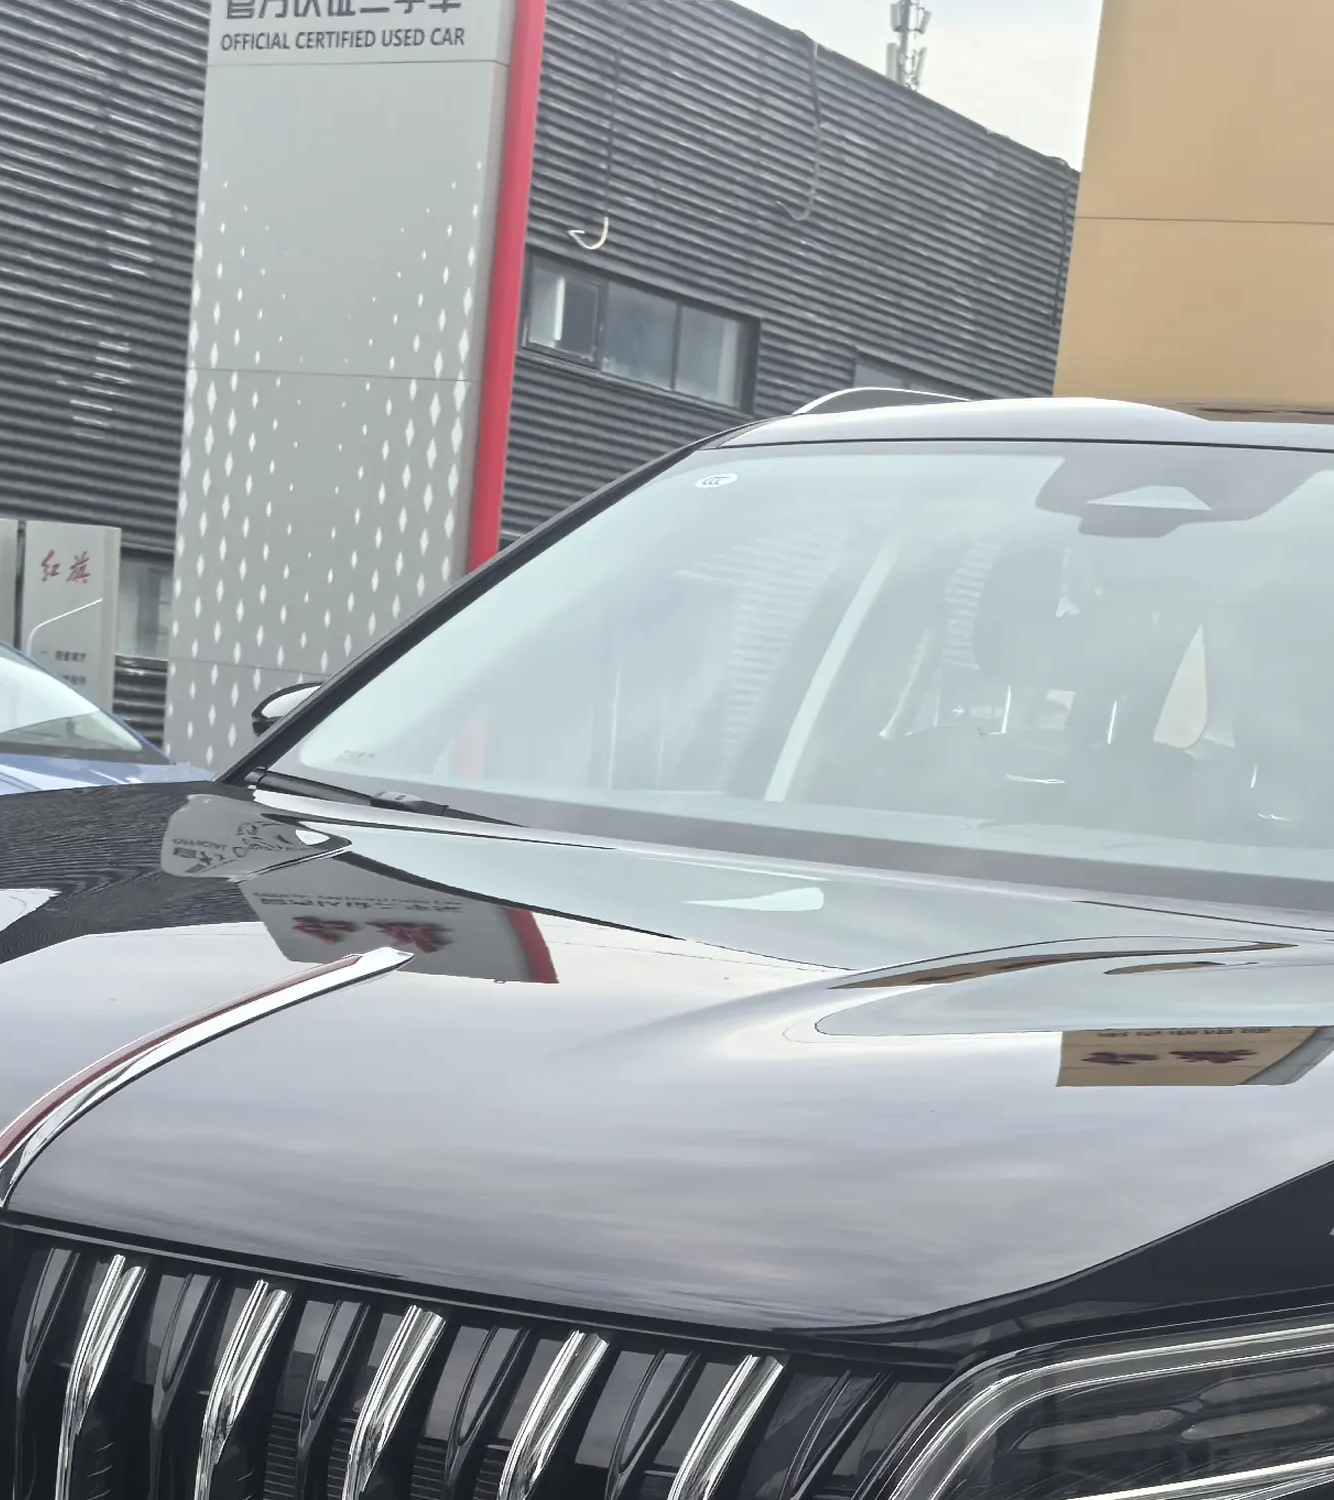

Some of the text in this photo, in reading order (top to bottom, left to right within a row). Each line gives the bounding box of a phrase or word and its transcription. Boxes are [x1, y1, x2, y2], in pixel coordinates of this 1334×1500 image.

[220, 27, 465, 51] OFFICIAL CERTIFIED USED CAR
[41, 549, 91, 584] 红旗
